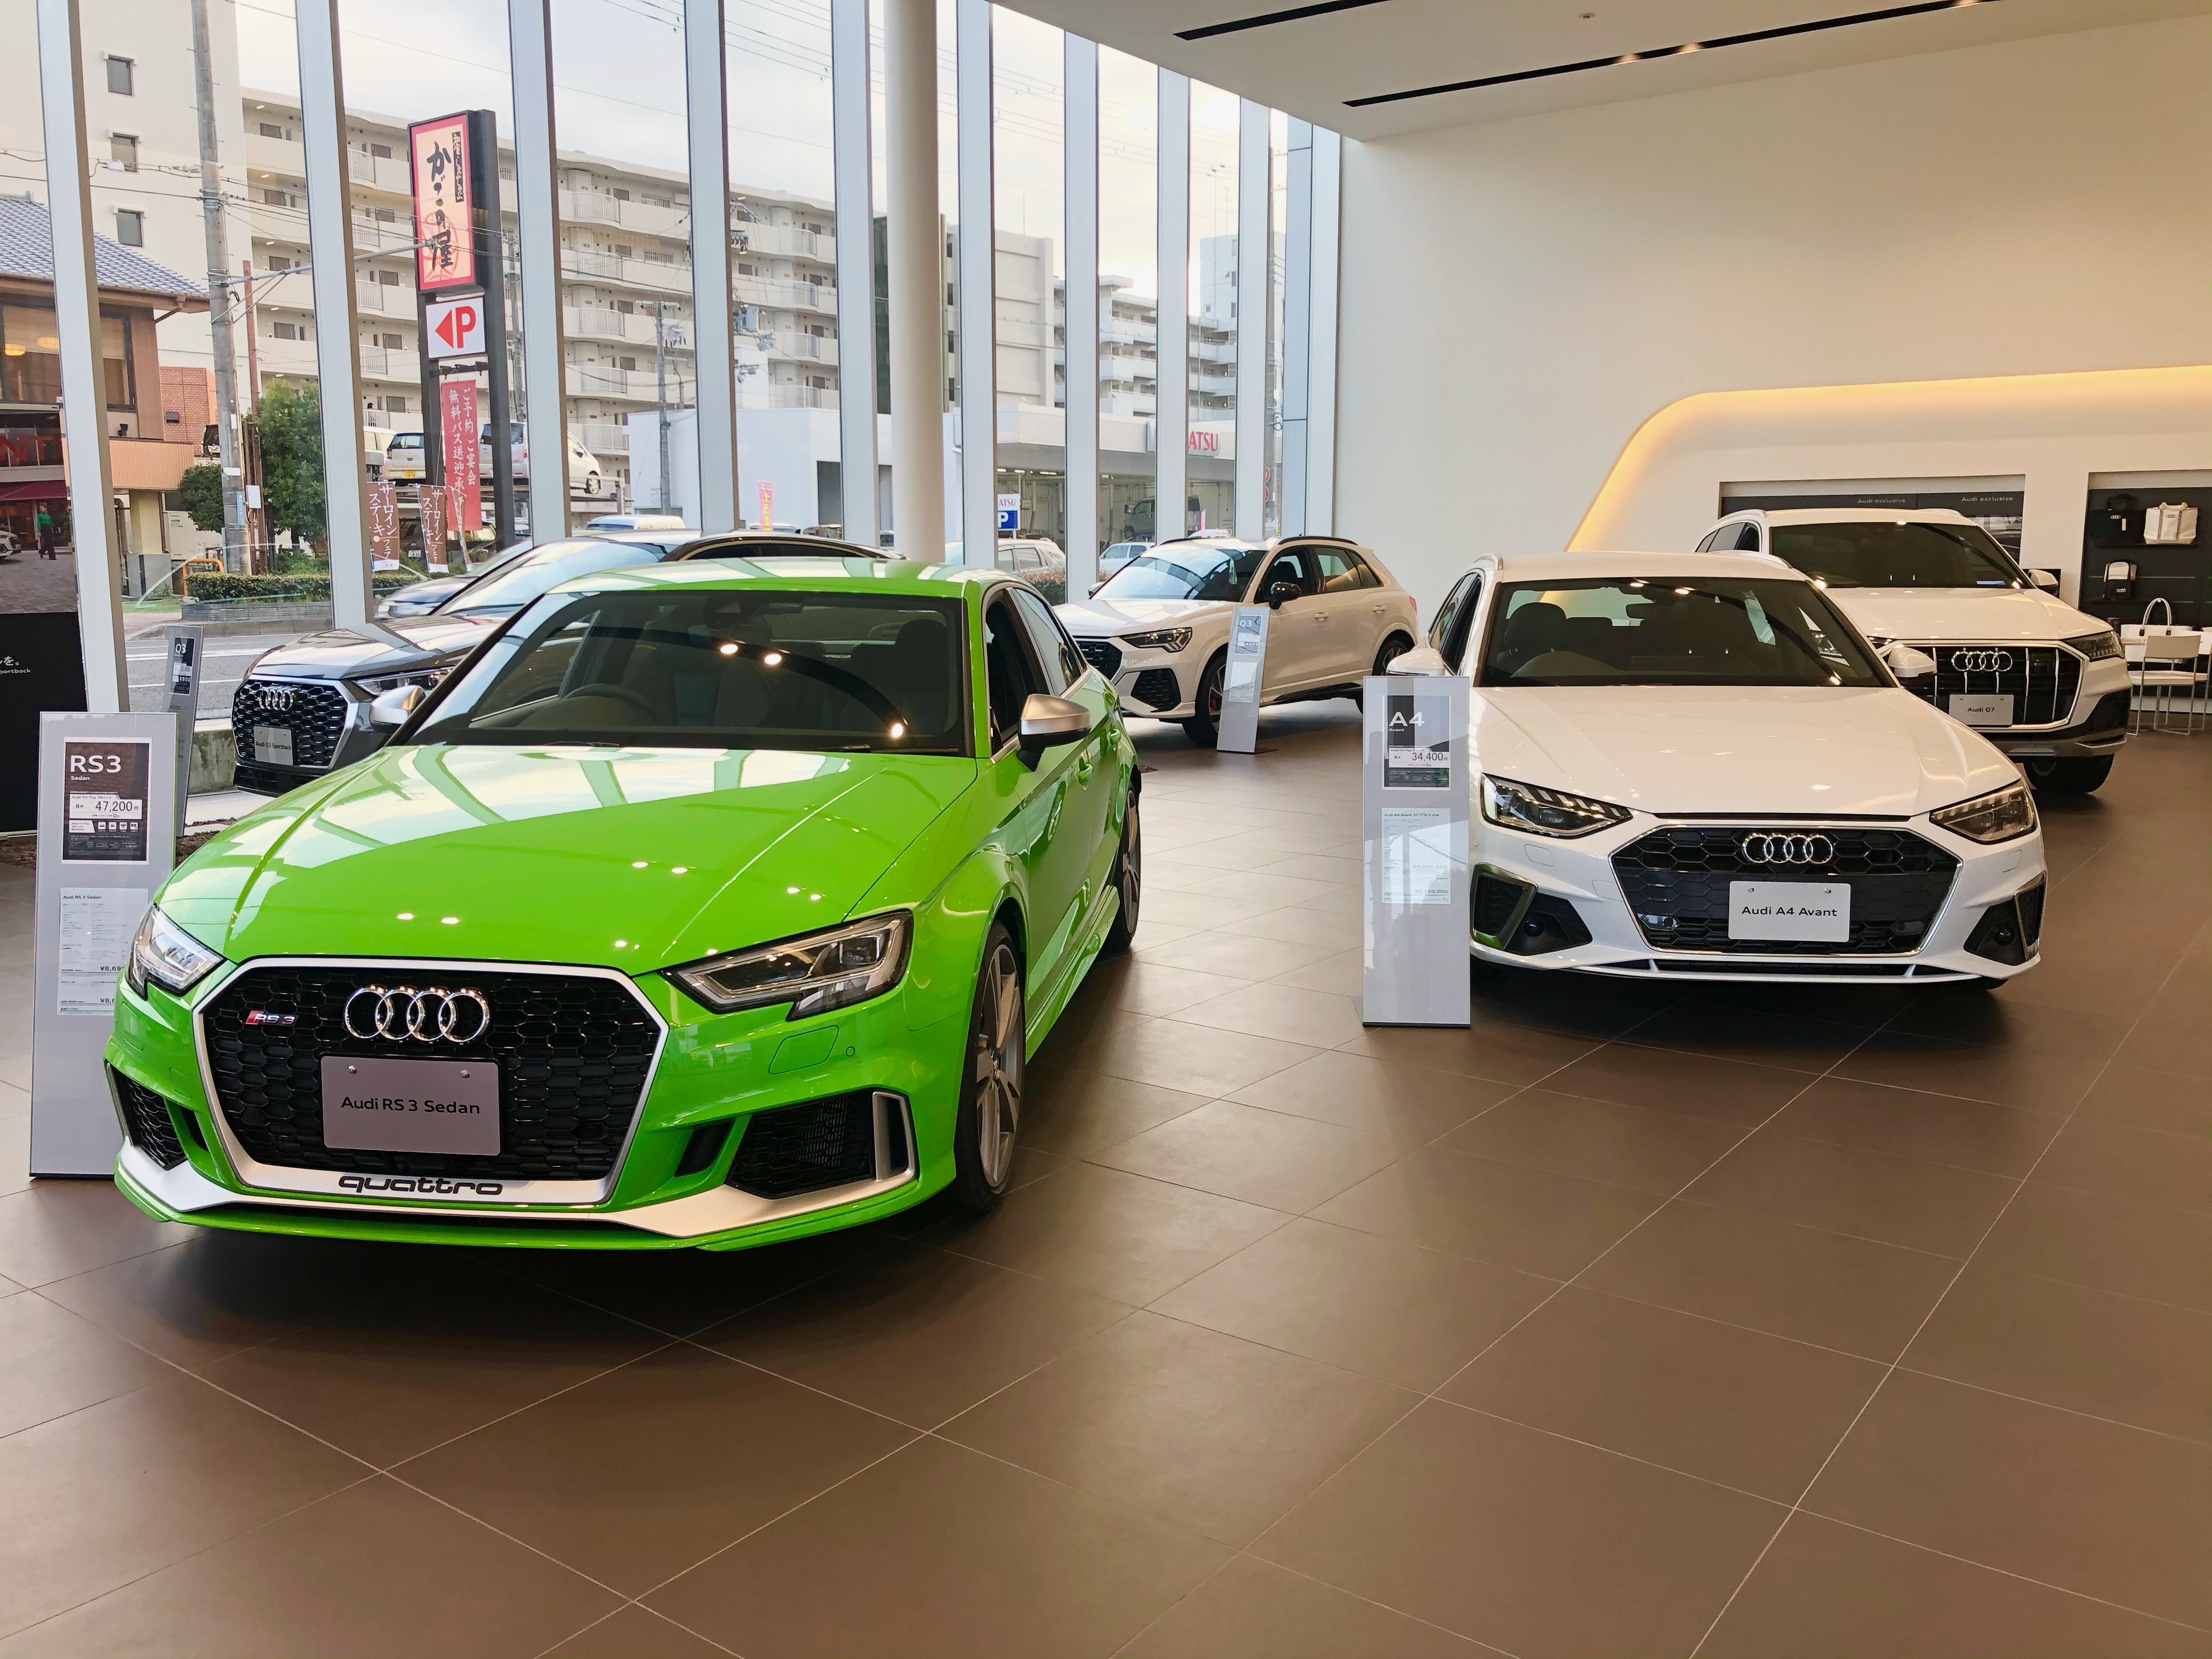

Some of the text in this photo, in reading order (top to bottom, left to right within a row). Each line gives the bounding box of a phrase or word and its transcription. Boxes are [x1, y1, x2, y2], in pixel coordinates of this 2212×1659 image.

[455, 306, 476, 348] P
[462, 387, 476, 486] ご予約 ご宴会
[369, 493, 385, 537] ステーキ
[379, 484, 397, 535] サーロイン
[422, 497, 434, 540] ステーキ
[431, 489, 443, 541] サーロイン
[997, 512, 1009, 528] P
[383, 539, 392, 559] フェア
[1240, 619, 1252, 628] Q3
[176, 644, 187, 654] Q3
[0, 656, 20, 666] を。
[1389, 712, 1425, 727] A4
[1412, 752, 1443, 761] 34,400
[95, 801, 133, 812] 47,200
[1741, 906, 1838, 917] Audi A4 Avant
[341, 1096, 481, 1114] Audi RS 3 Sedan
[338, 1175, 503, 1196] quattro
